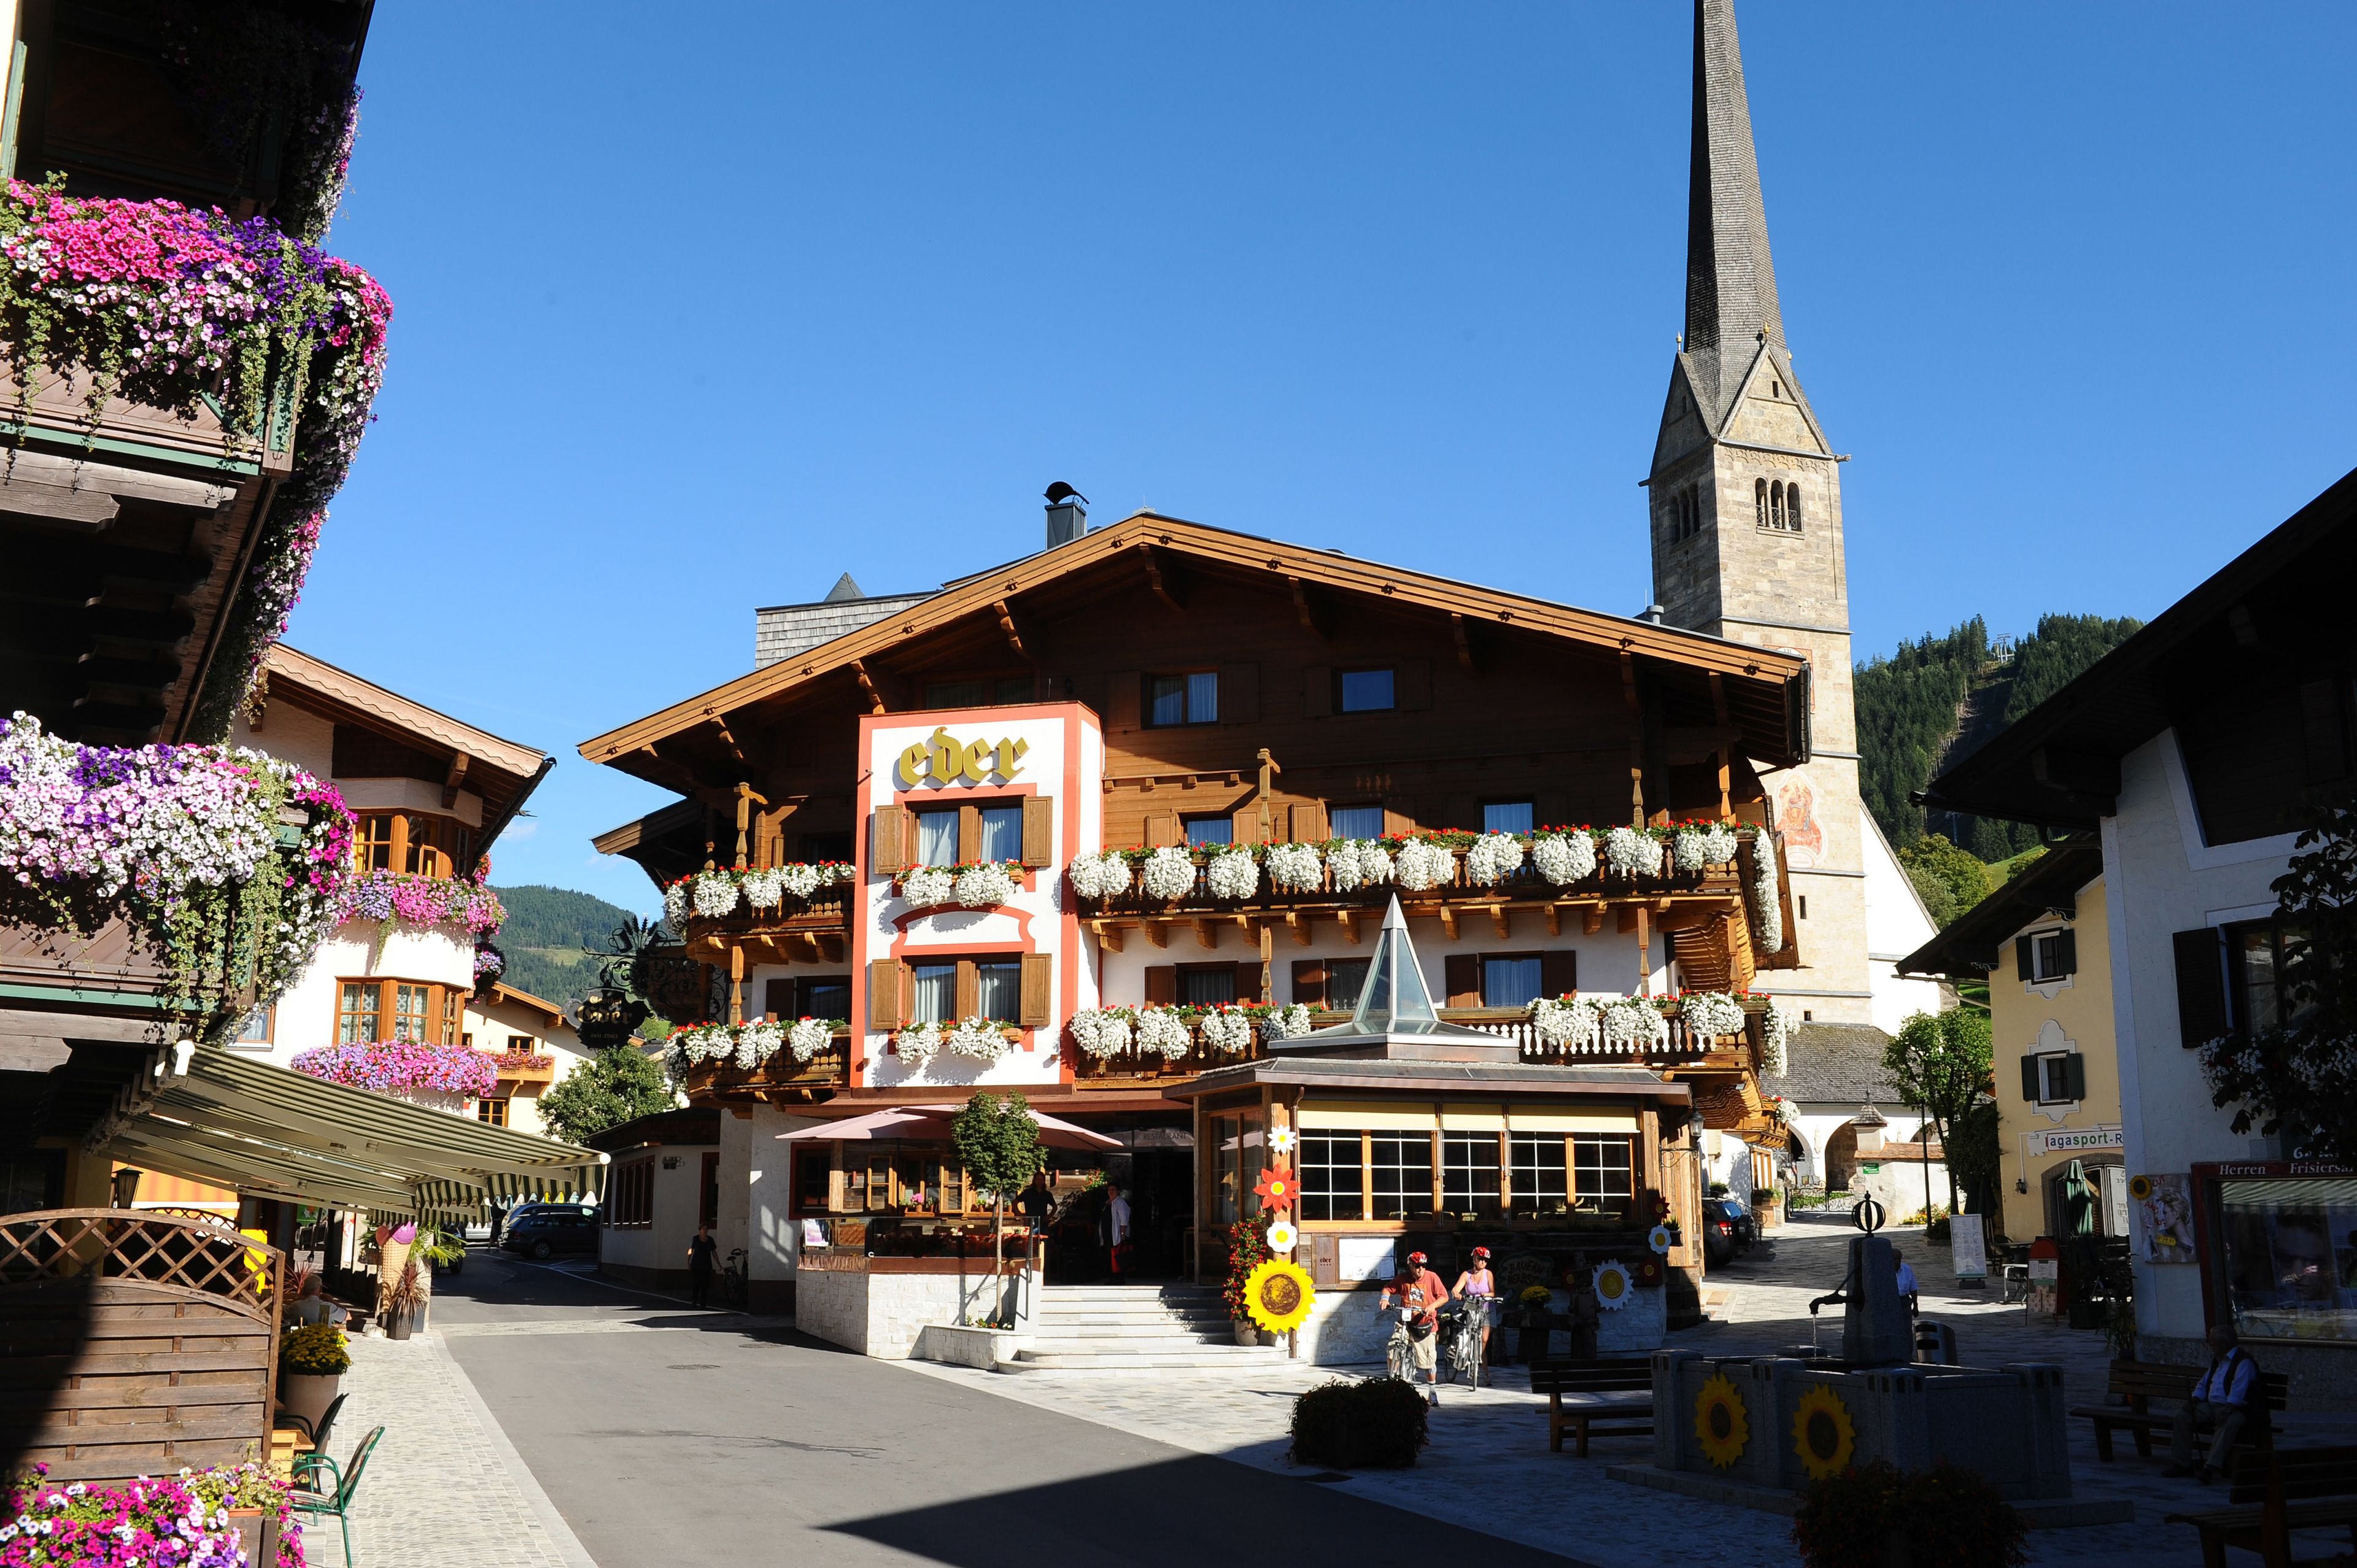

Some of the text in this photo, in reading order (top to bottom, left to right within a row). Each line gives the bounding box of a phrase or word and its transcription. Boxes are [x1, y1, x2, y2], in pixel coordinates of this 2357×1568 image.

[899, 726, 1029, 786] eder
[578, 1005, 632, 1024] Eder
[2220, 1163, 2266, 1175] Herren
